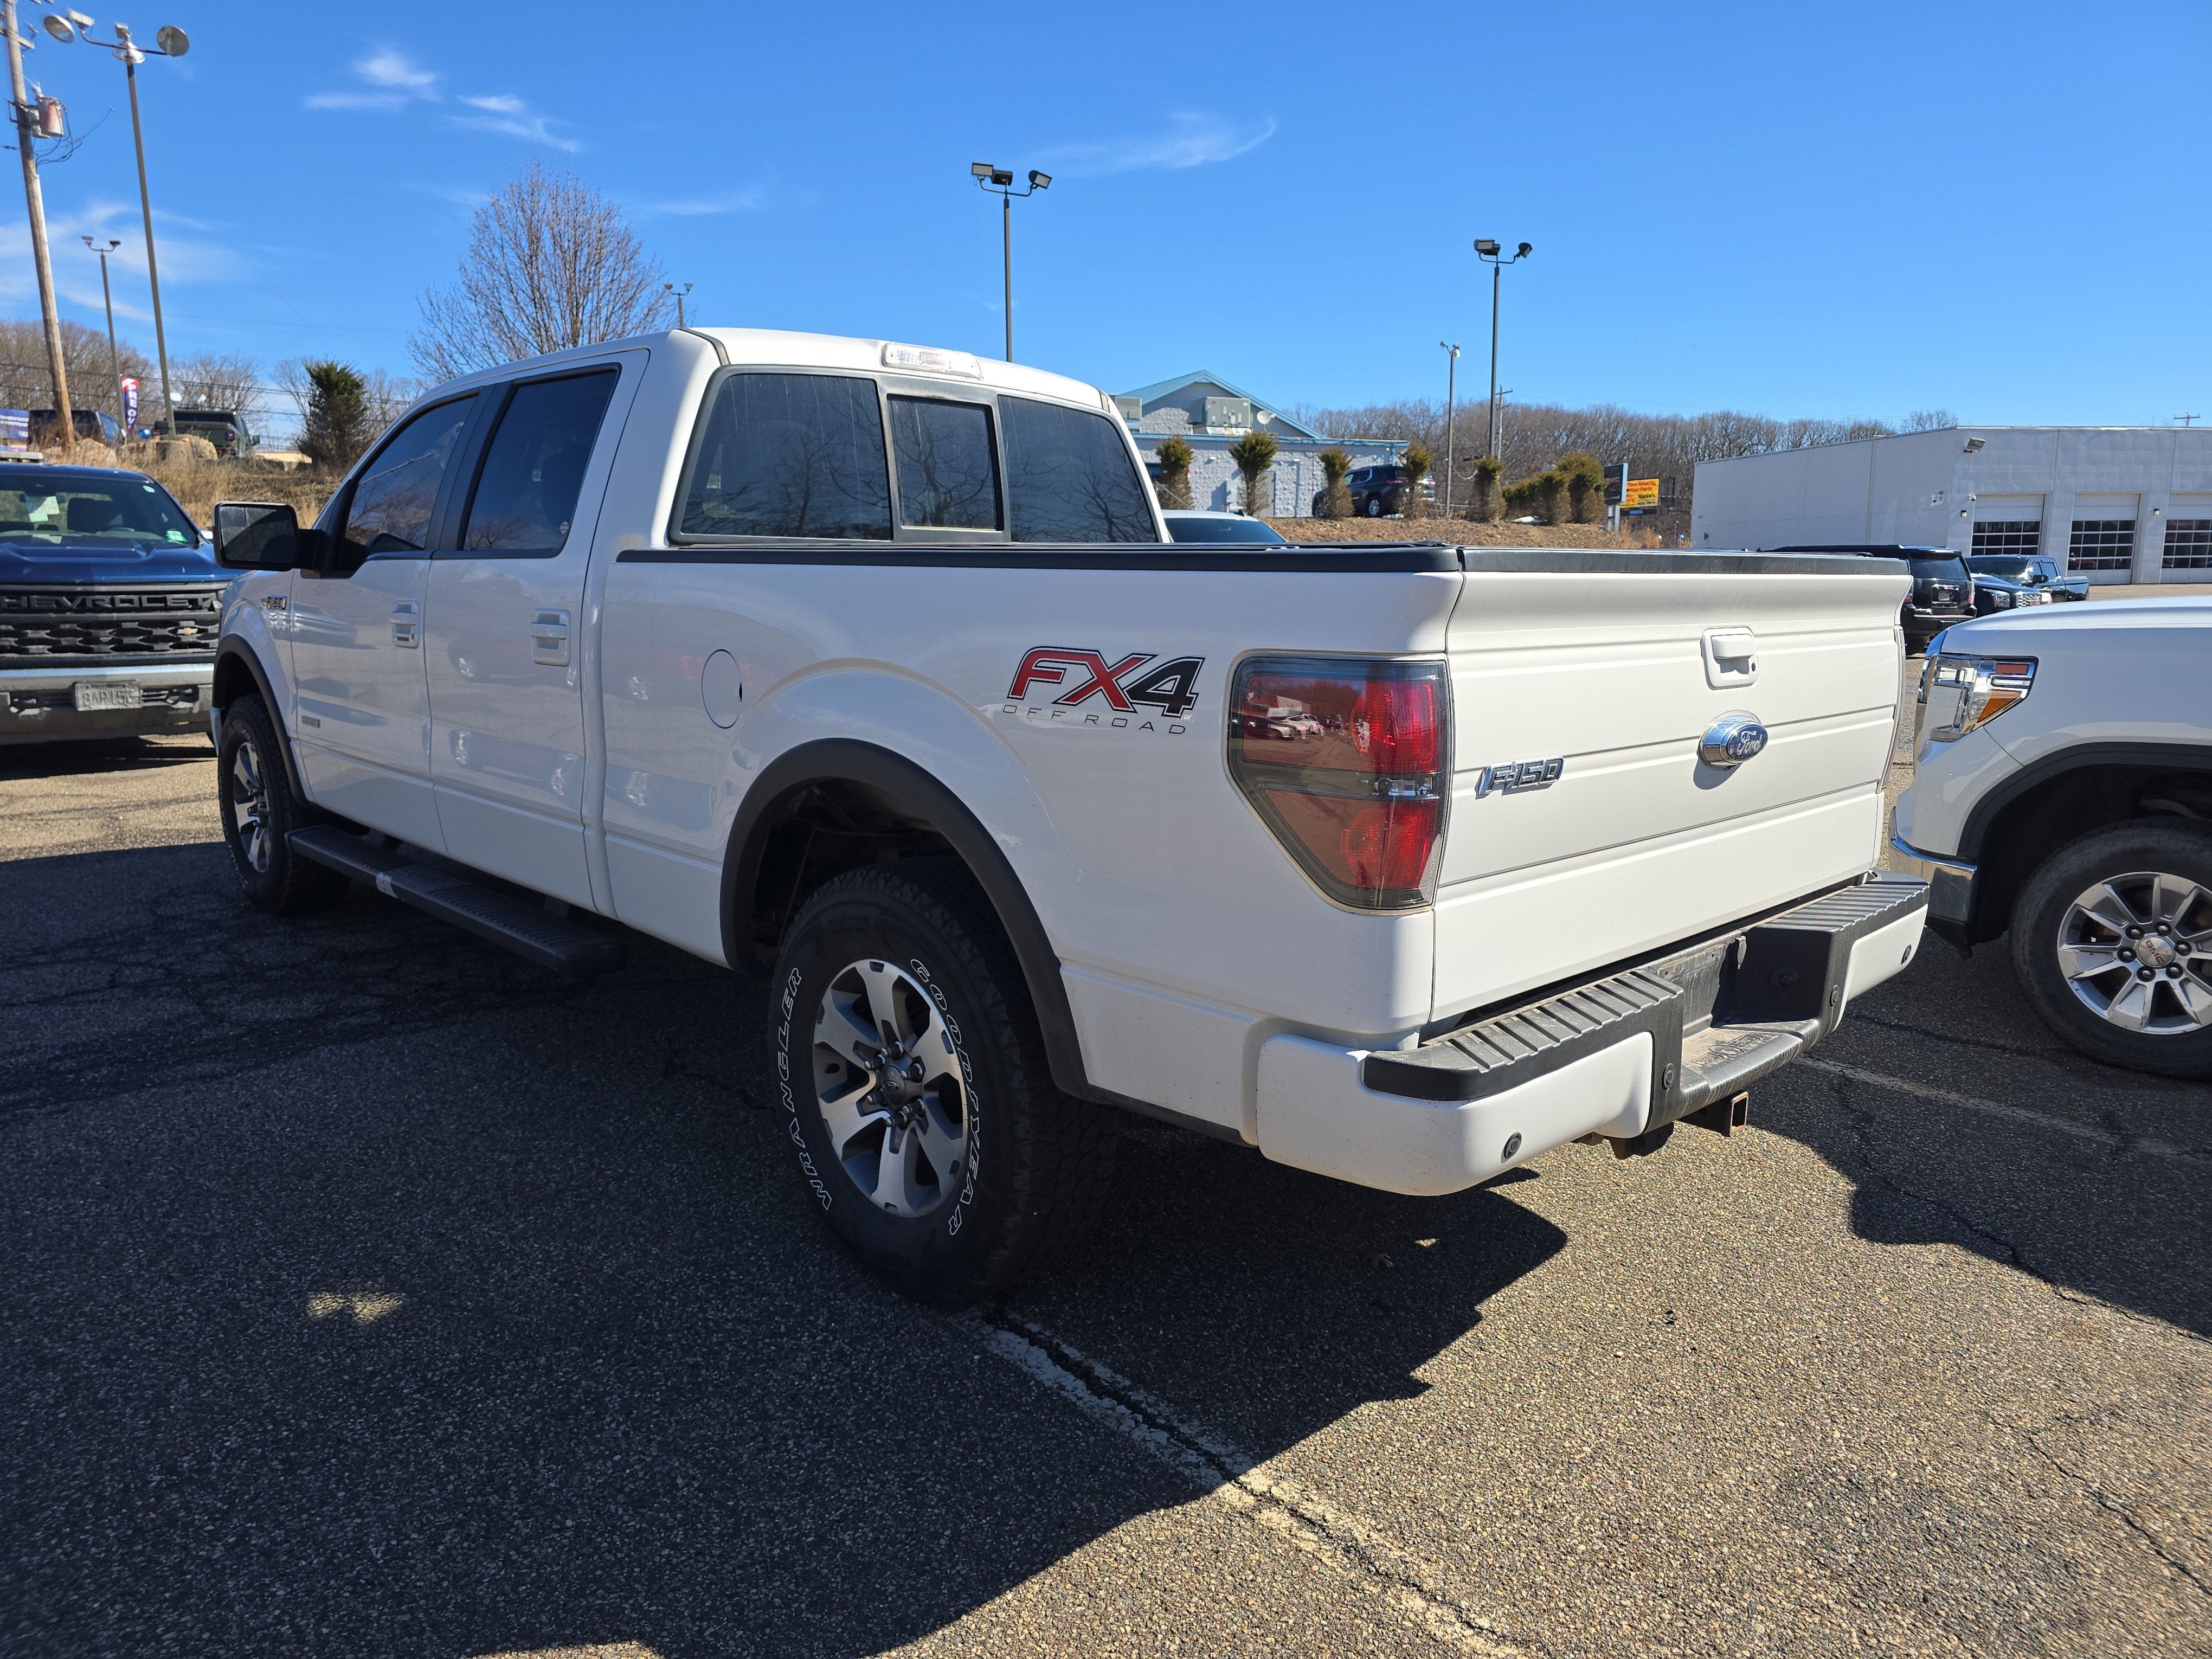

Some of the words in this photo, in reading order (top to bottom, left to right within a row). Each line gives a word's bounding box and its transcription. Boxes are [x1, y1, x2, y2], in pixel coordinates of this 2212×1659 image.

[1007, 645, 1206, 718] FX4
[1002, 705, 1066, 719] OFF
[1084, 714, 1186, 735] ROAD
[1737, 730, 1764, 756] Ford
[2146, 940, 2164, 964] GMC
[777, 967, 832, 1211] WRANGLER
[910, 959, 980, 1236] GOODYEAR
